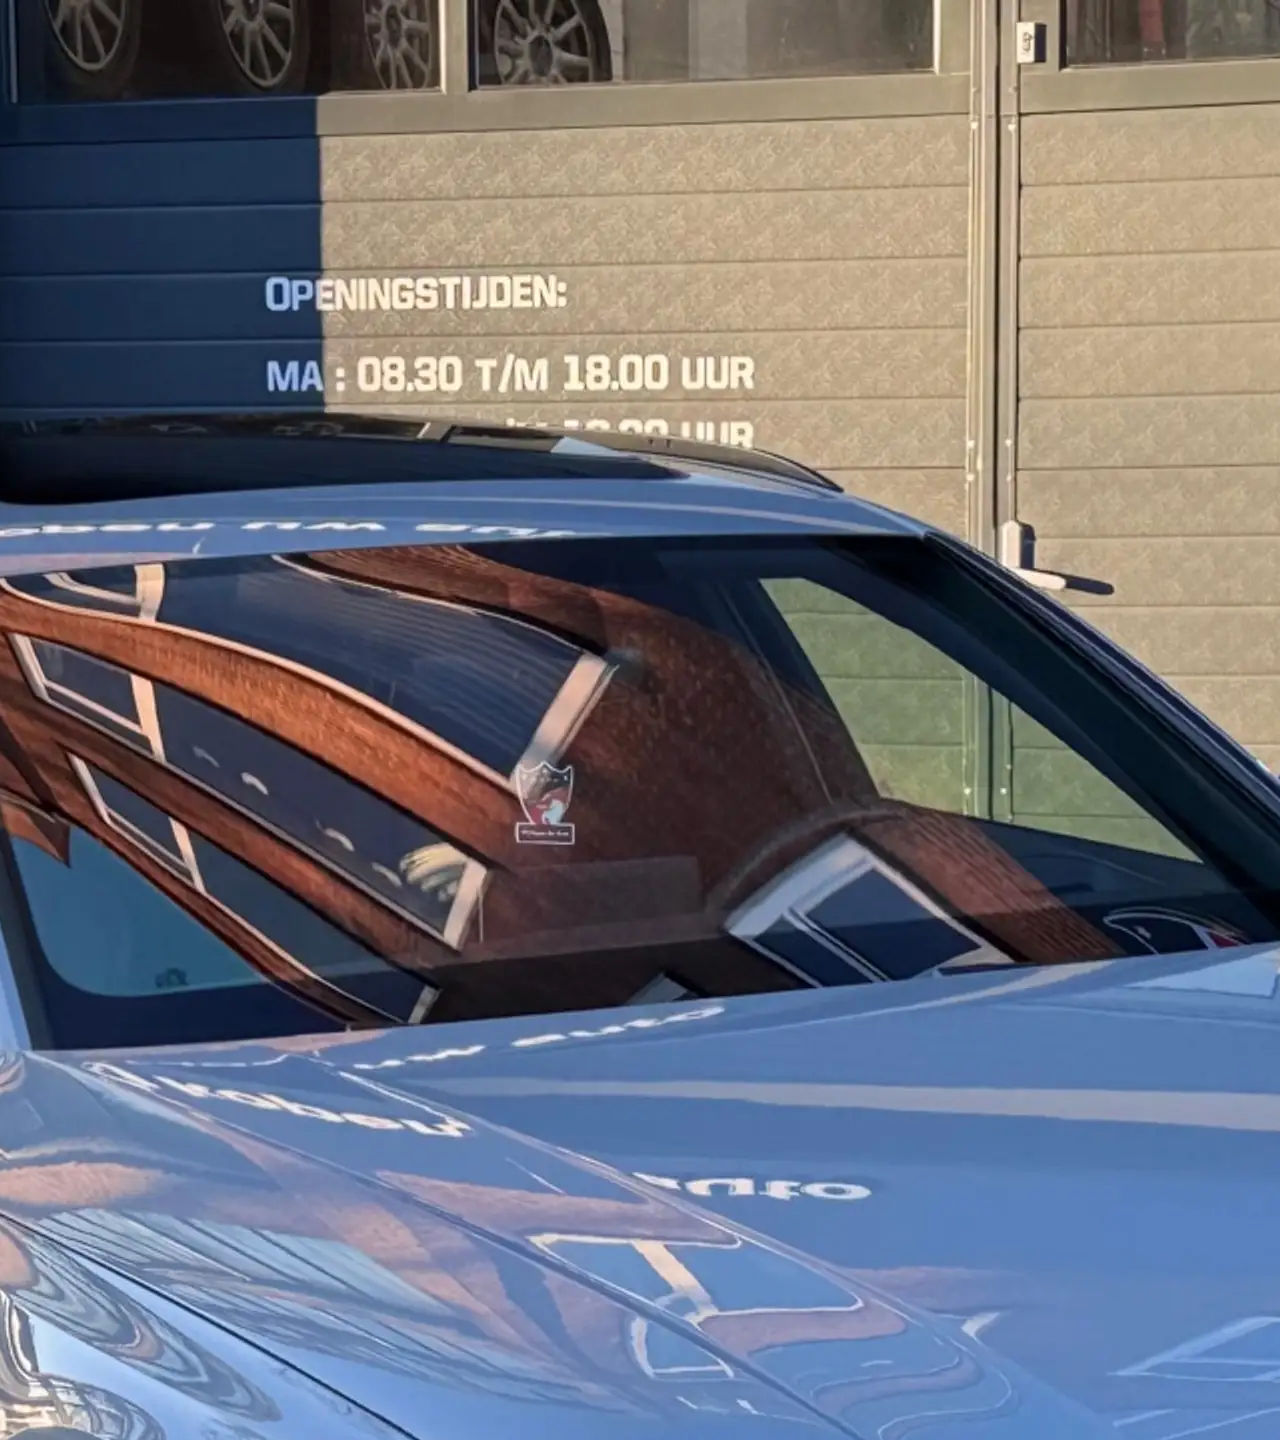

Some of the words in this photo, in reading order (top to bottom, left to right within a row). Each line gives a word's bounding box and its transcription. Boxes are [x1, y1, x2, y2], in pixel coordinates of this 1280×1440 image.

[265, 274, 568, 312] OPENINGSTIJDEN:
[266, 360, 324, 392] MA
[356, 356, 464, 393] 08.30
[475, 353, 549, 394] T/M
[563, 353, 669, 392] 18.00
[681, 354, 755, 391] UUR
